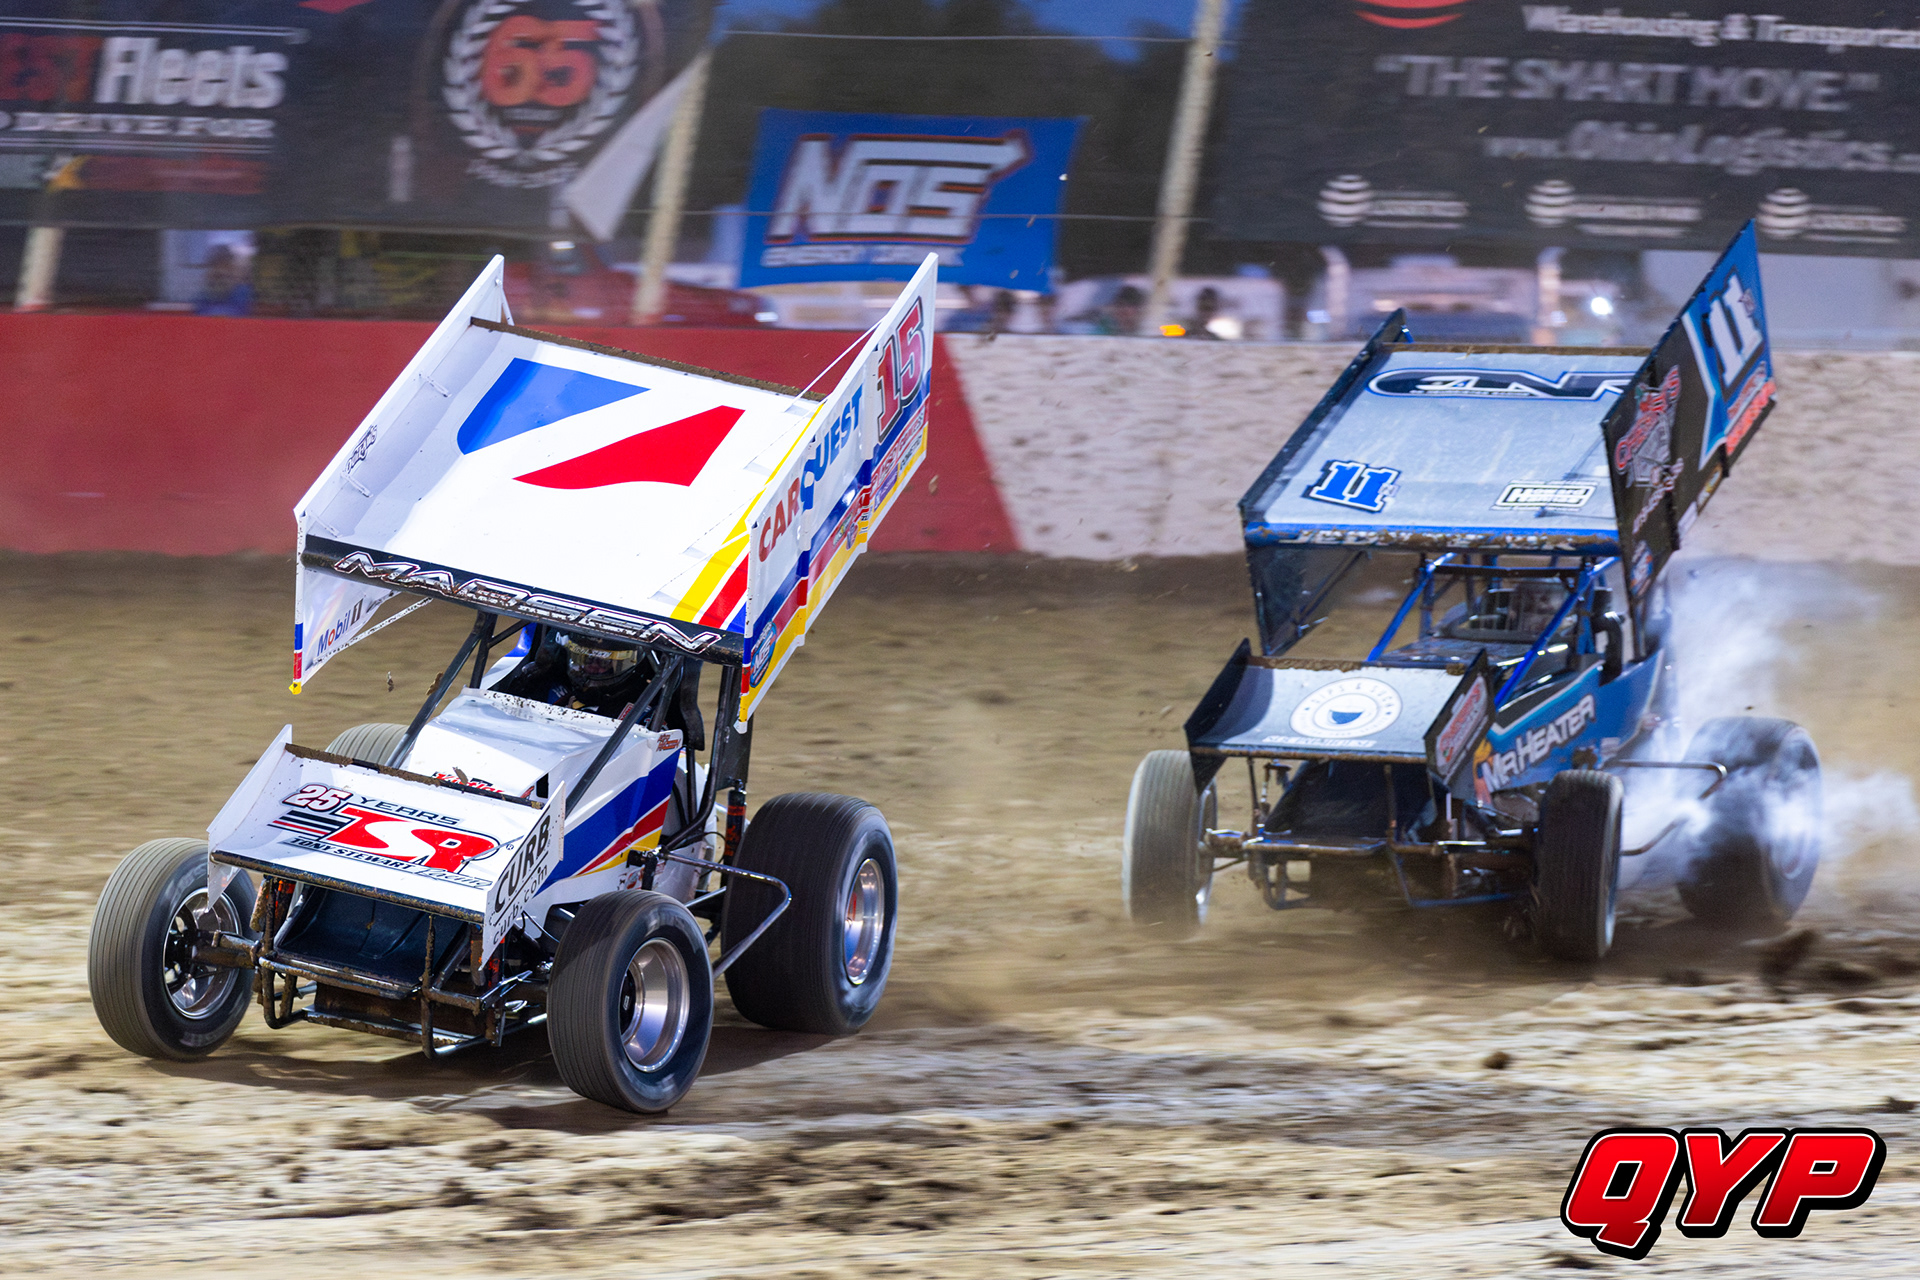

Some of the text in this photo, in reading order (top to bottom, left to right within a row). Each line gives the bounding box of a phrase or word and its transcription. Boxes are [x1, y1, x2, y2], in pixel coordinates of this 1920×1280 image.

[96, 37, 289, 109] Fleets
[1512, 58, 1689, 102] SMART
[765, 130, 1030, 244] NOS
[877, 296, 926, 443] 15
[758, 383, 864, 563] CARQUEST
[1303, 461, 1400, 512] 11
[317, 597, 364, 656] Mobil 1
[1516, 693, 1597, 772] HEATER
[282, 784, 458, 826] 25 YEARS
[291, 837, 334, 852] TONY
[333, 848, 415, 870] STEWART
[495, 814, 551, 913] CURB
